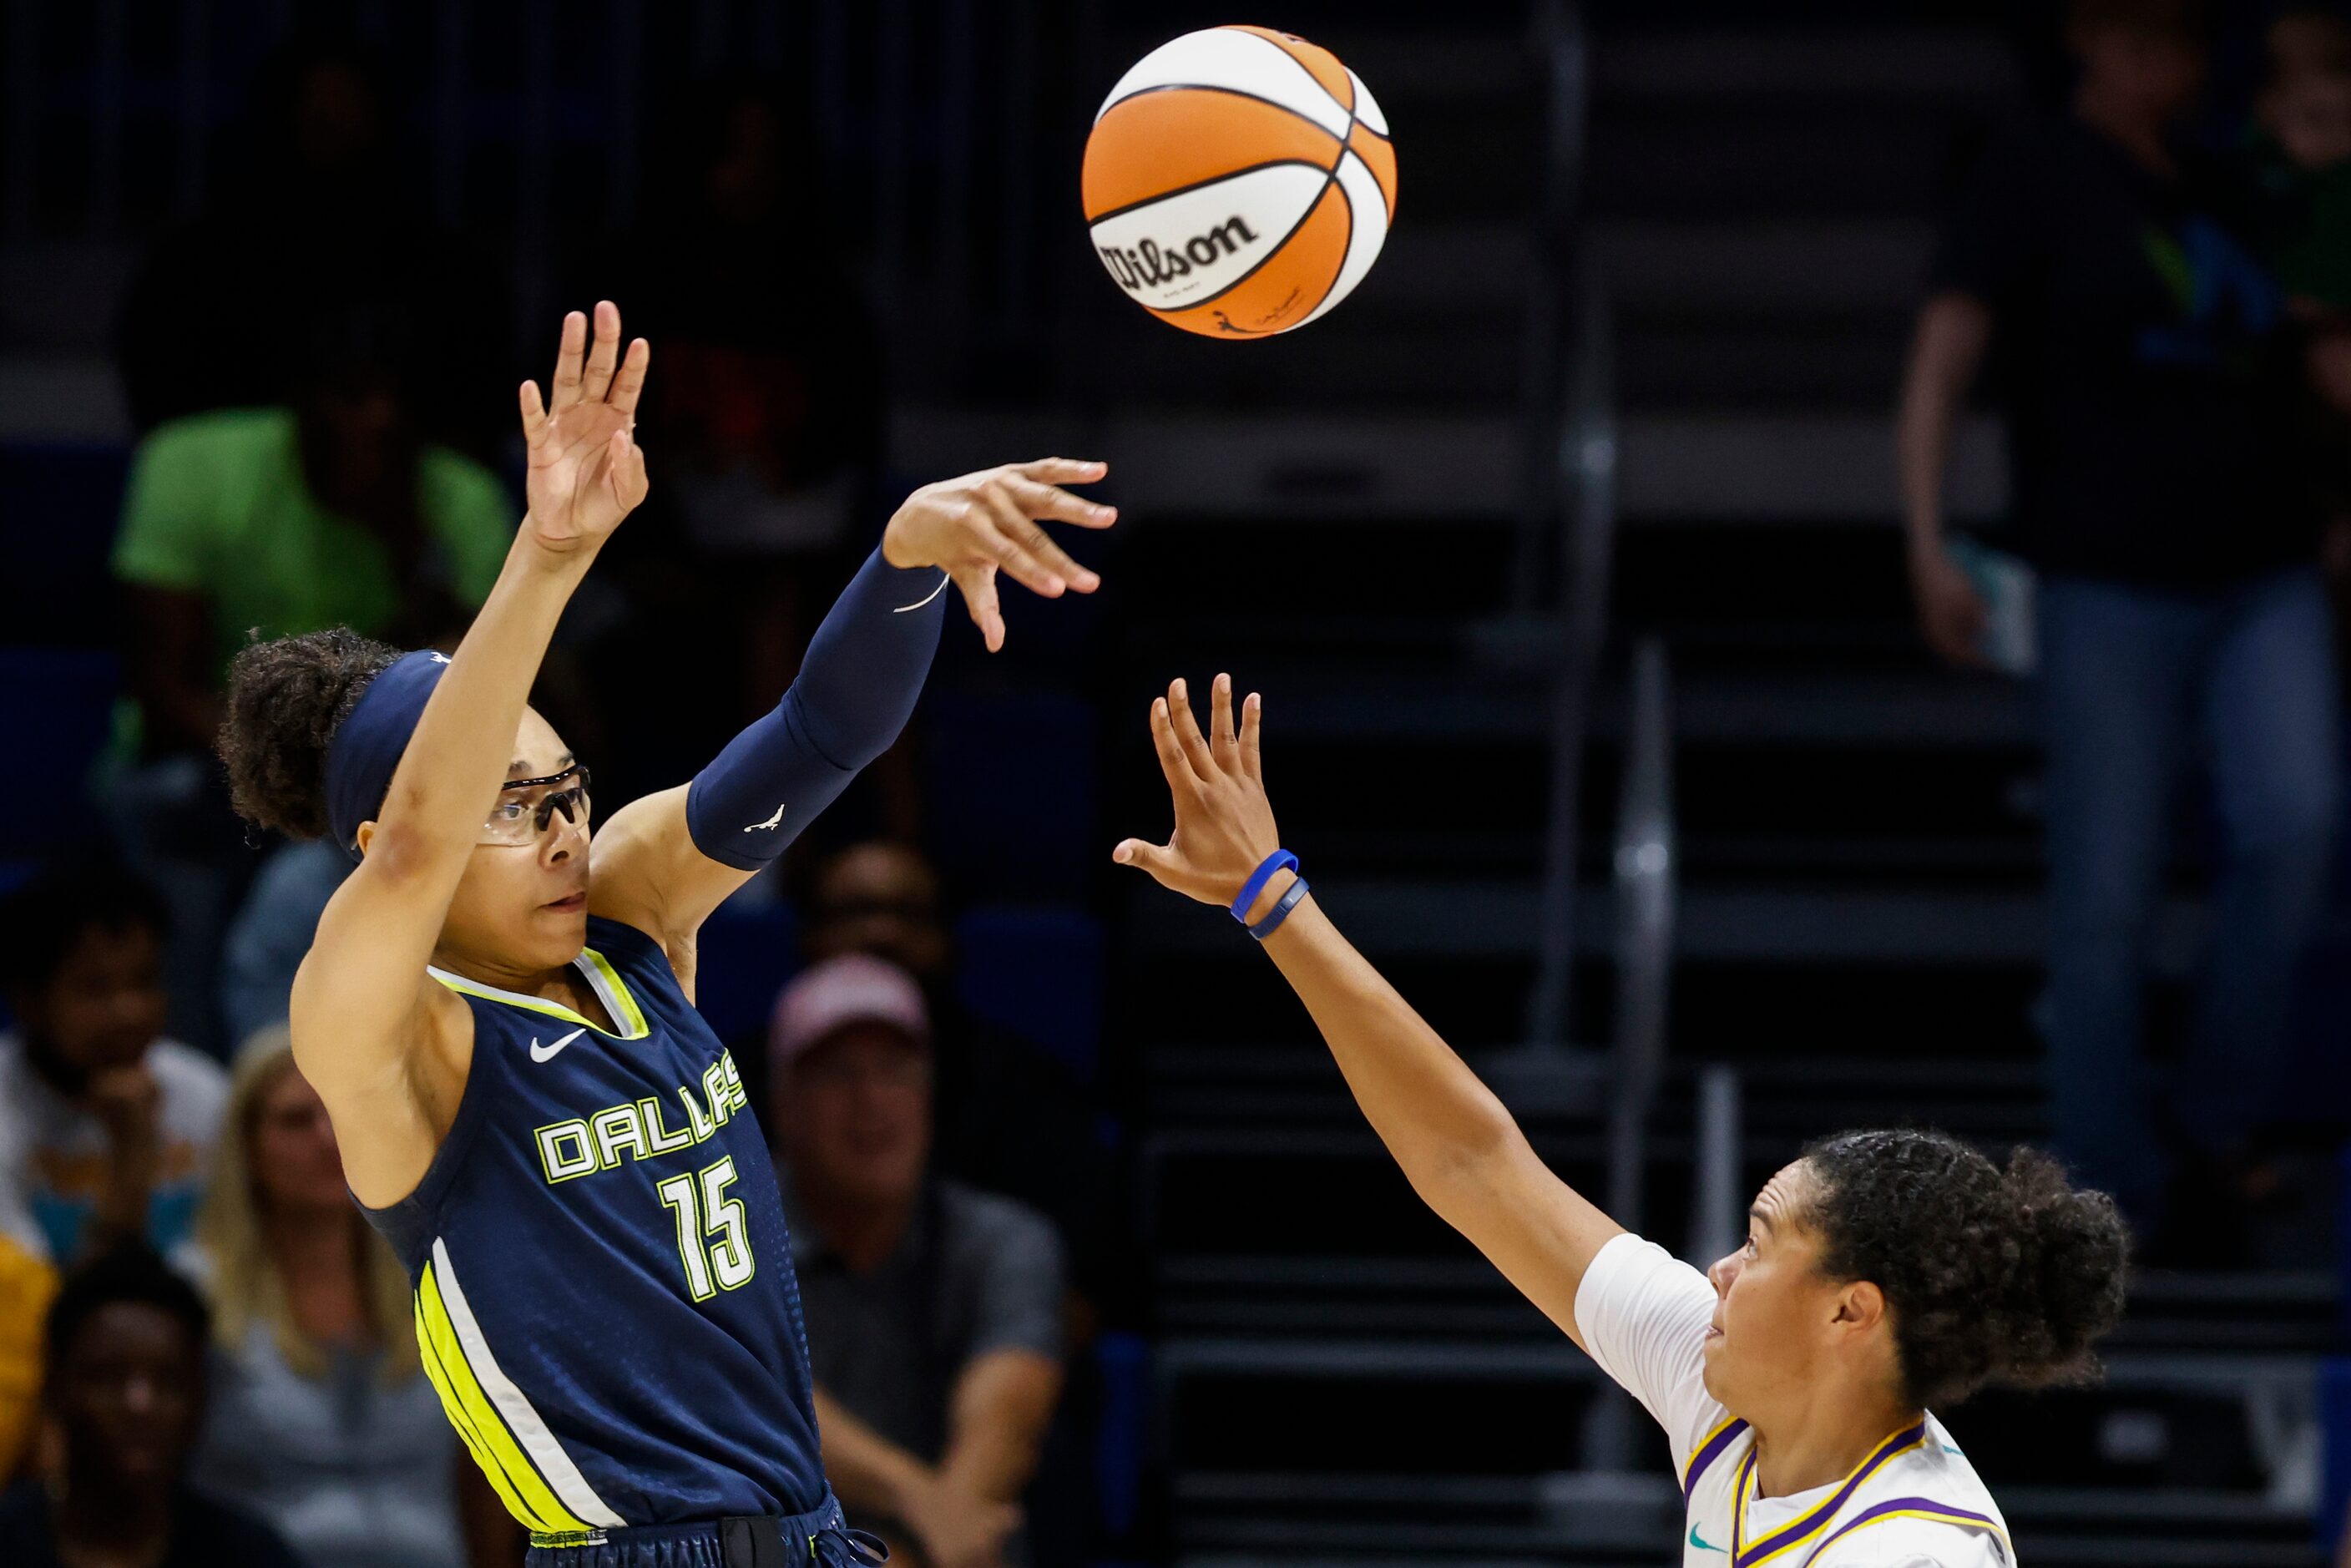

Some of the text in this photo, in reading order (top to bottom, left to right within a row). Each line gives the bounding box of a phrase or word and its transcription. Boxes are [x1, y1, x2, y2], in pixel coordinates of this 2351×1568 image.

[1100, 215, 1259, 291] Wilson
[533, 1048, 747, 1184] DALLAS
[656, 1155, 755, 1302] 15
